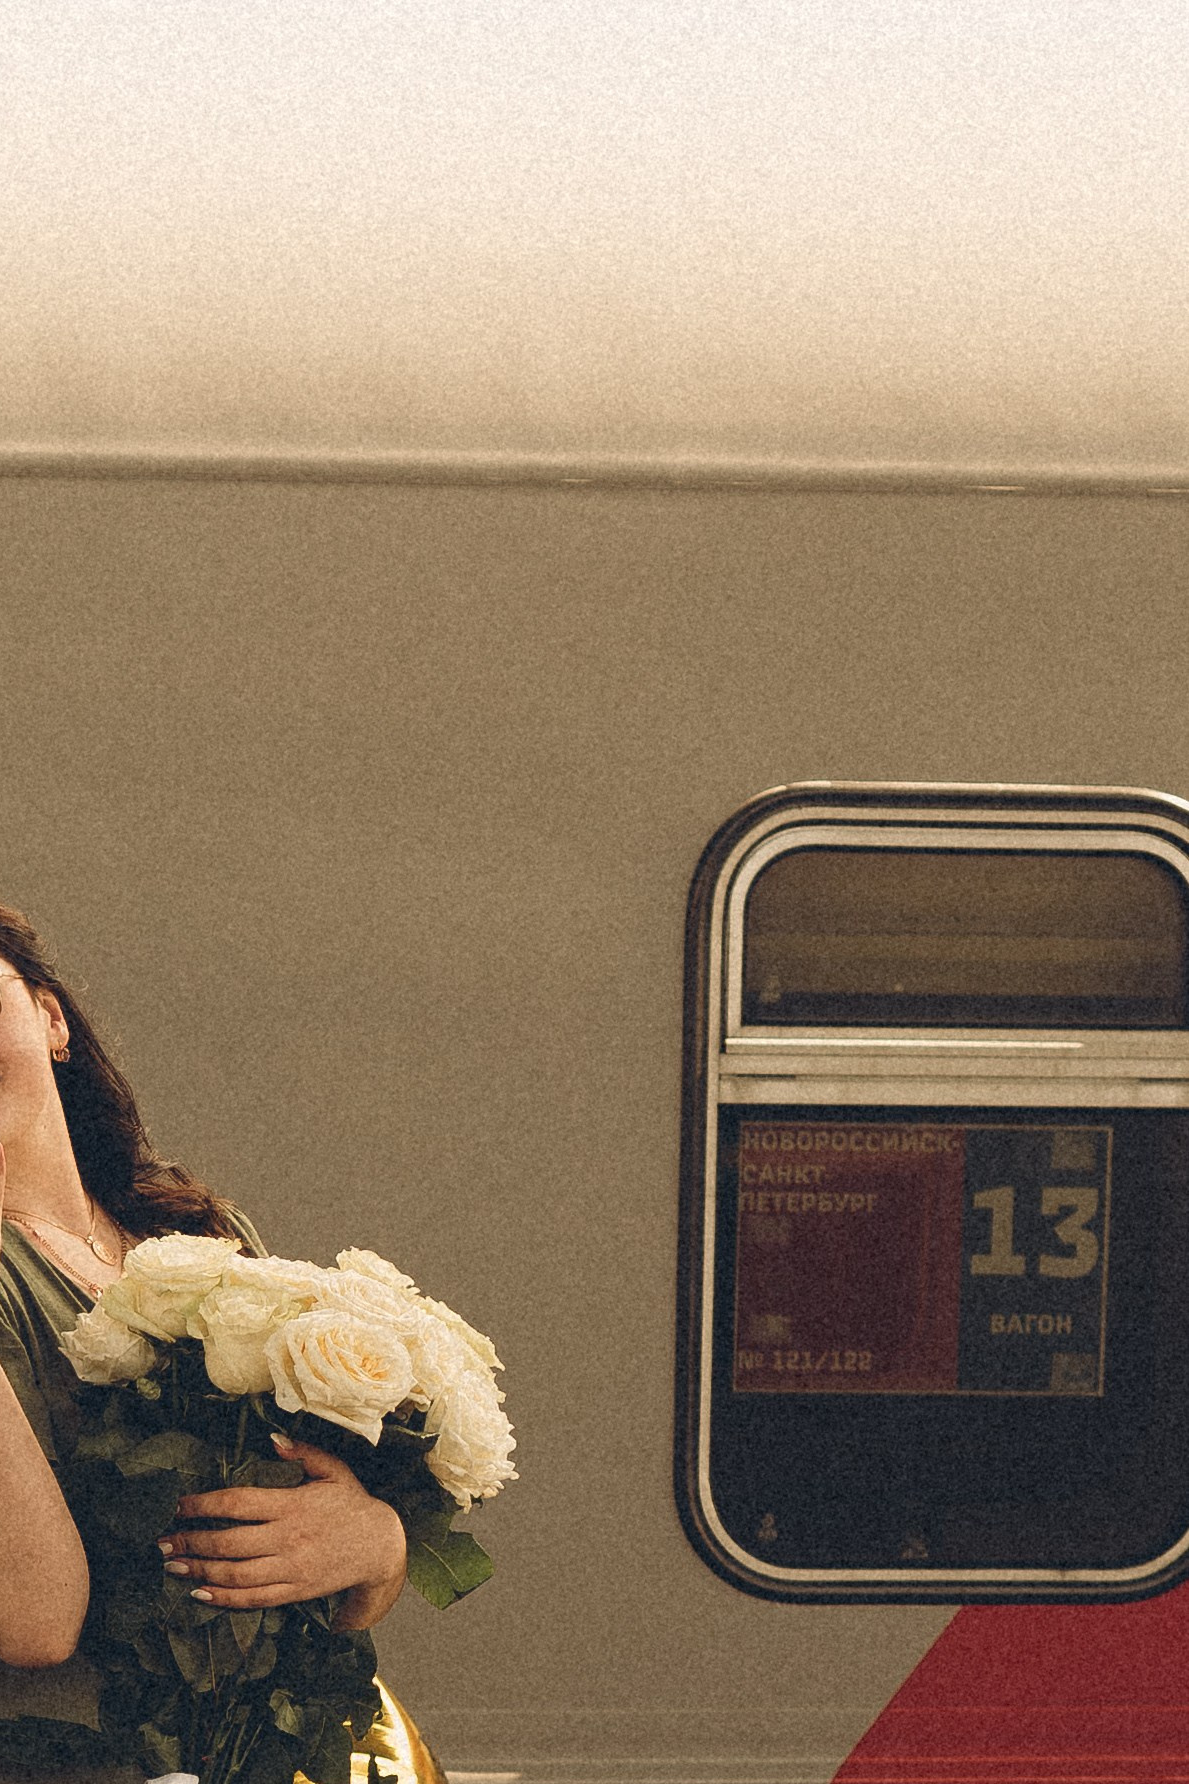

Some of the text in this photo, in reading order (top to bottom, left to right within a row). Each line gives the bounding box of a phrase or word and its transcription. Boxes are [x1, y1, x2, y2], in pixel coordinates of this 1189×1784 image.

[739, 1190, 879, 1213] ПЕТЕРБУРГ
[970, 1186, 1099, 1279] 13
[989, 1314, 1073, 1335] ВАГОН
